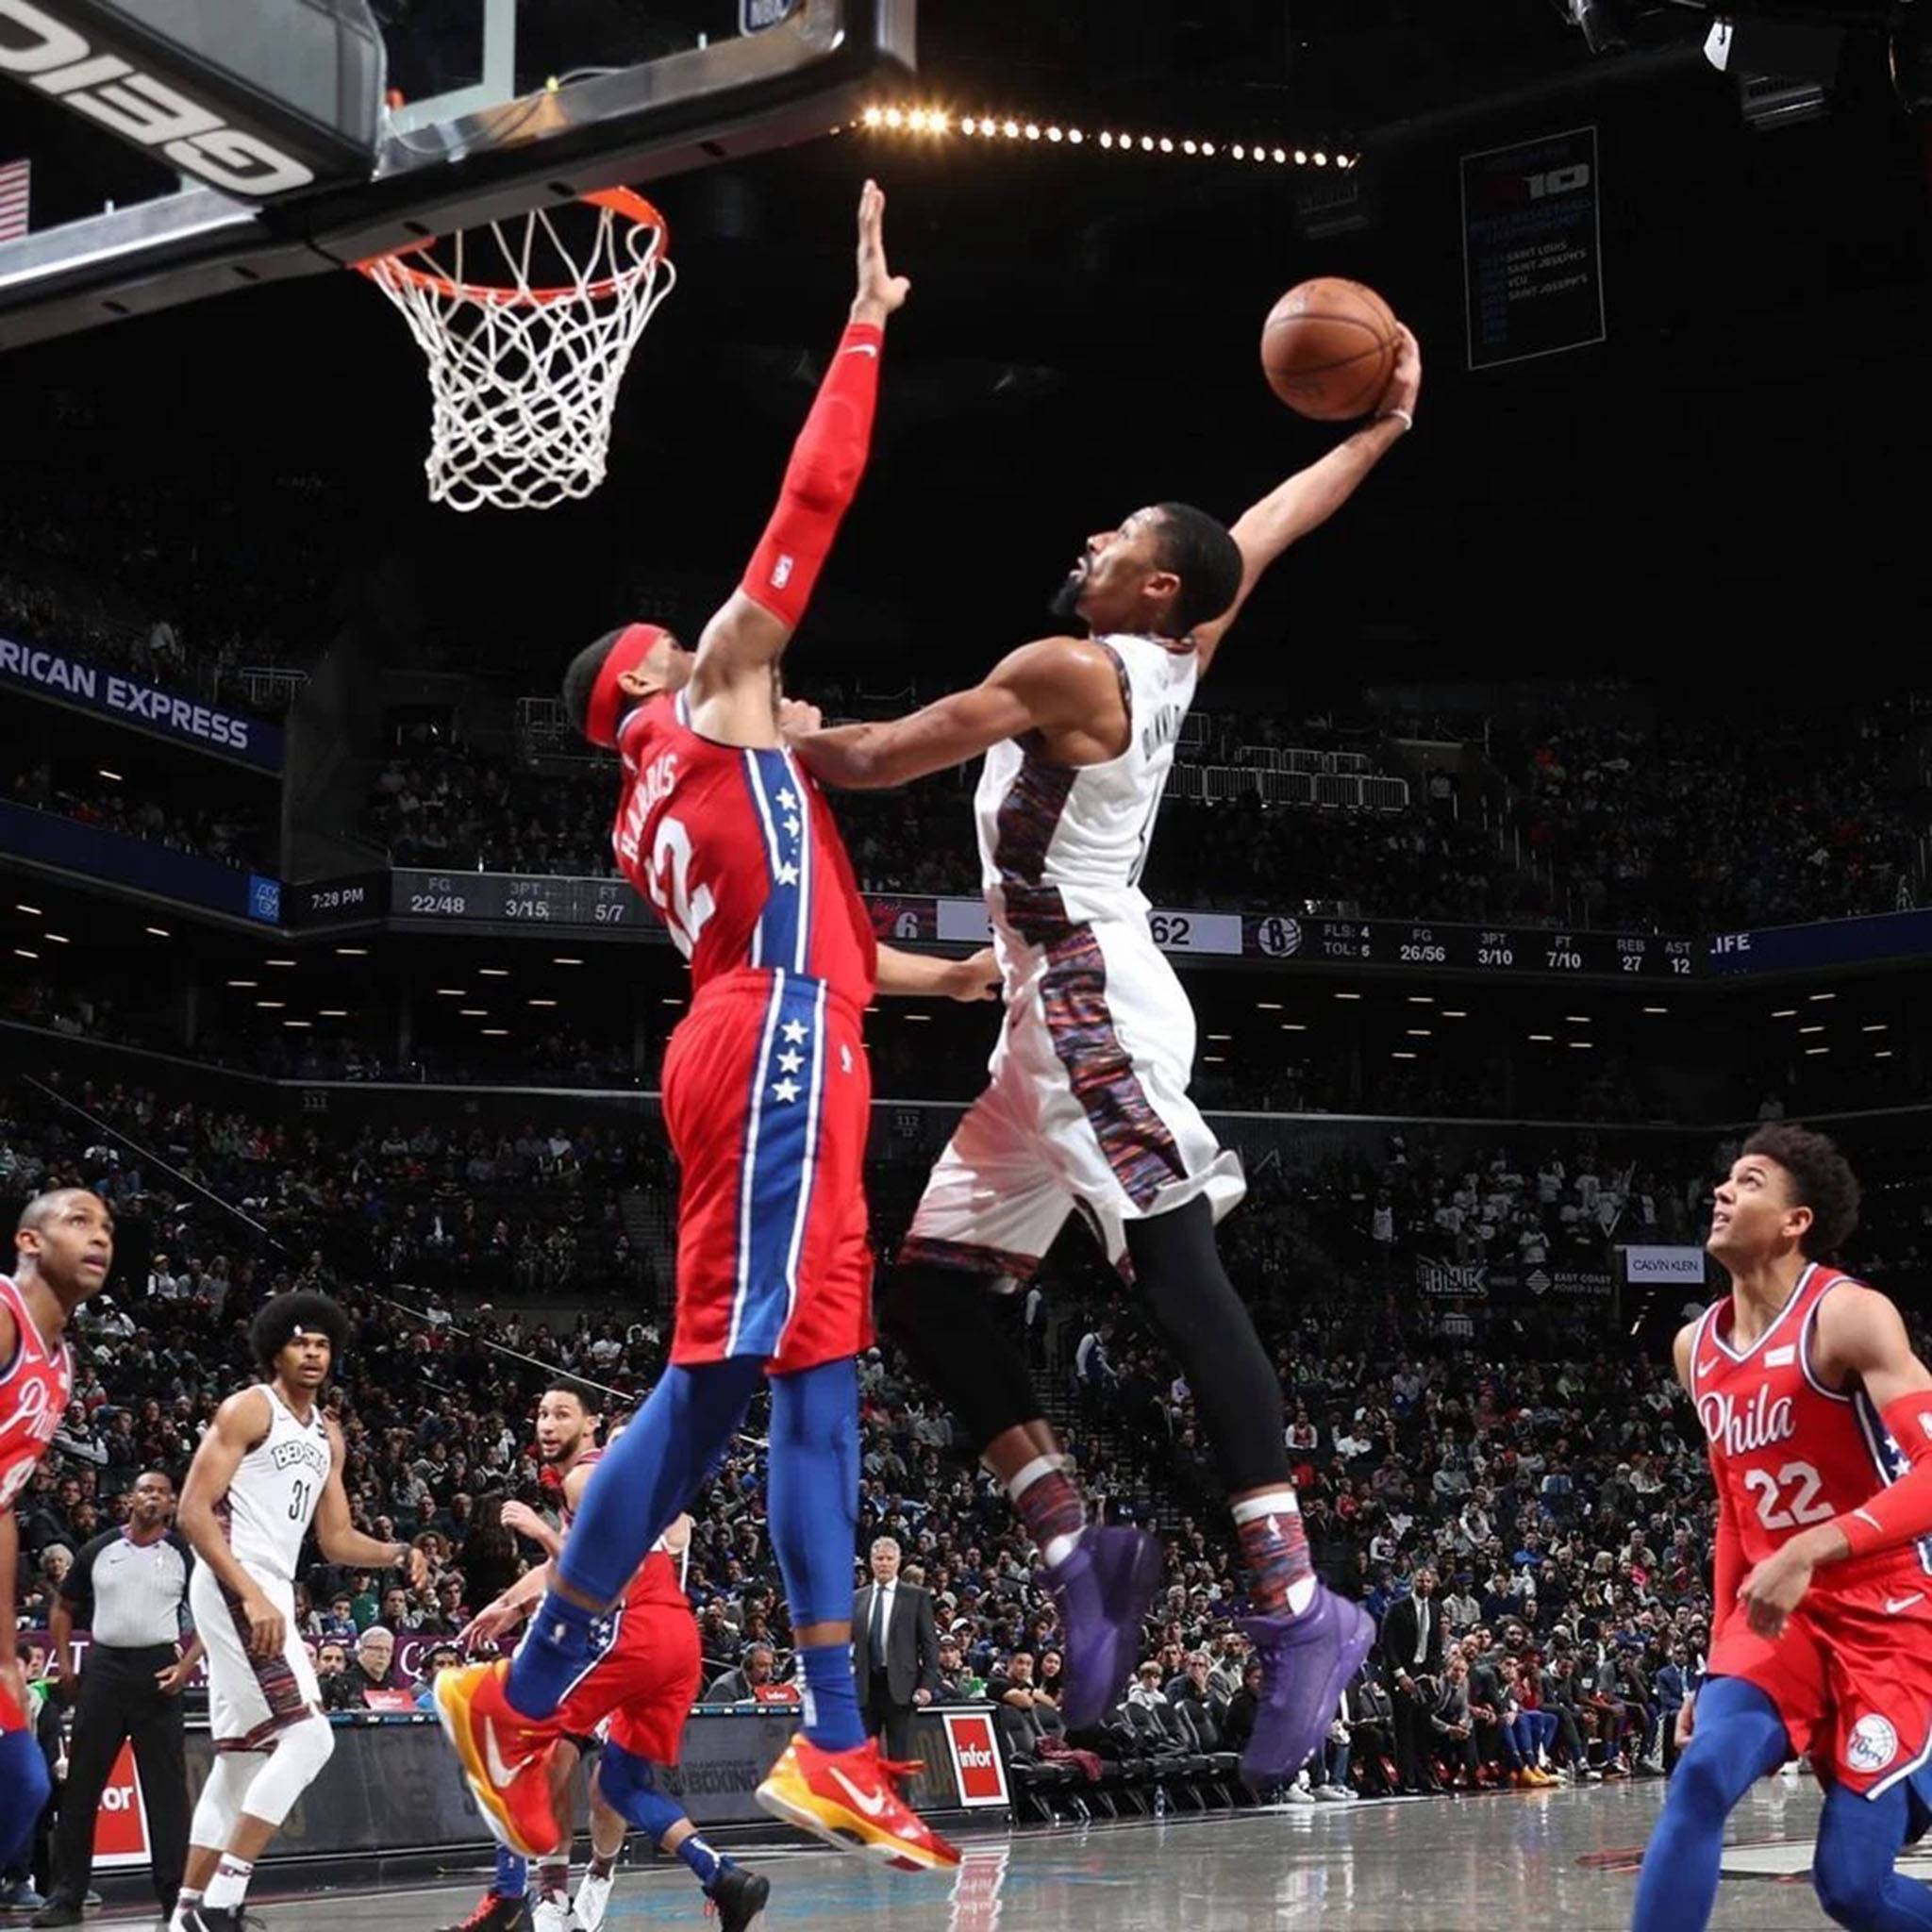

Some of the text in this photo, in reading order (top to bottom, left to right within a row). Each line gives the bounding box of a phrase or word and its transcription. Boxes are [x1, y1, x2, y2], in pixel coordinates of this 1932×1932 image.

[107, 675, 249, 750] EXPRESS
[428, 877, 452, 892] FG
[311, 888, 364, 910] 7:28 PM
[411, 895, 466, 914] 22/48
[594, 905, 625, 922] 5/7
[1151, 916, 1191, 945] 62
[1324, 924, 1370, 939] FLS: 4
[1412, 928, 1432, 941] FG
[1481, 932, 1507, 945] 3PT
[1324, 941, 1371, 958] TOL: 5
[1616, 938, 1645, 953] REB
[1664, 941, 1692, 955] AST
[1709, 932, 1752, 955] IFE
[1400, 944, 1446, 962] 26/56
[1477, 949, 1513, 965] 3/10
[1546, 951, 1581, 969] 7/10
[1622, 955, 1642, 972] 27
[1670, 958, 1691, 974] 12
[1632, 1258, 1699, 1273] CALVIN KLEIN
[1697, 1383, 1796, 1457] Phila
[289, 1479, 310, 1523] 31
[1745, 1461, 1836, 1530] 22
[958, 1742, 992, 1769] infor
